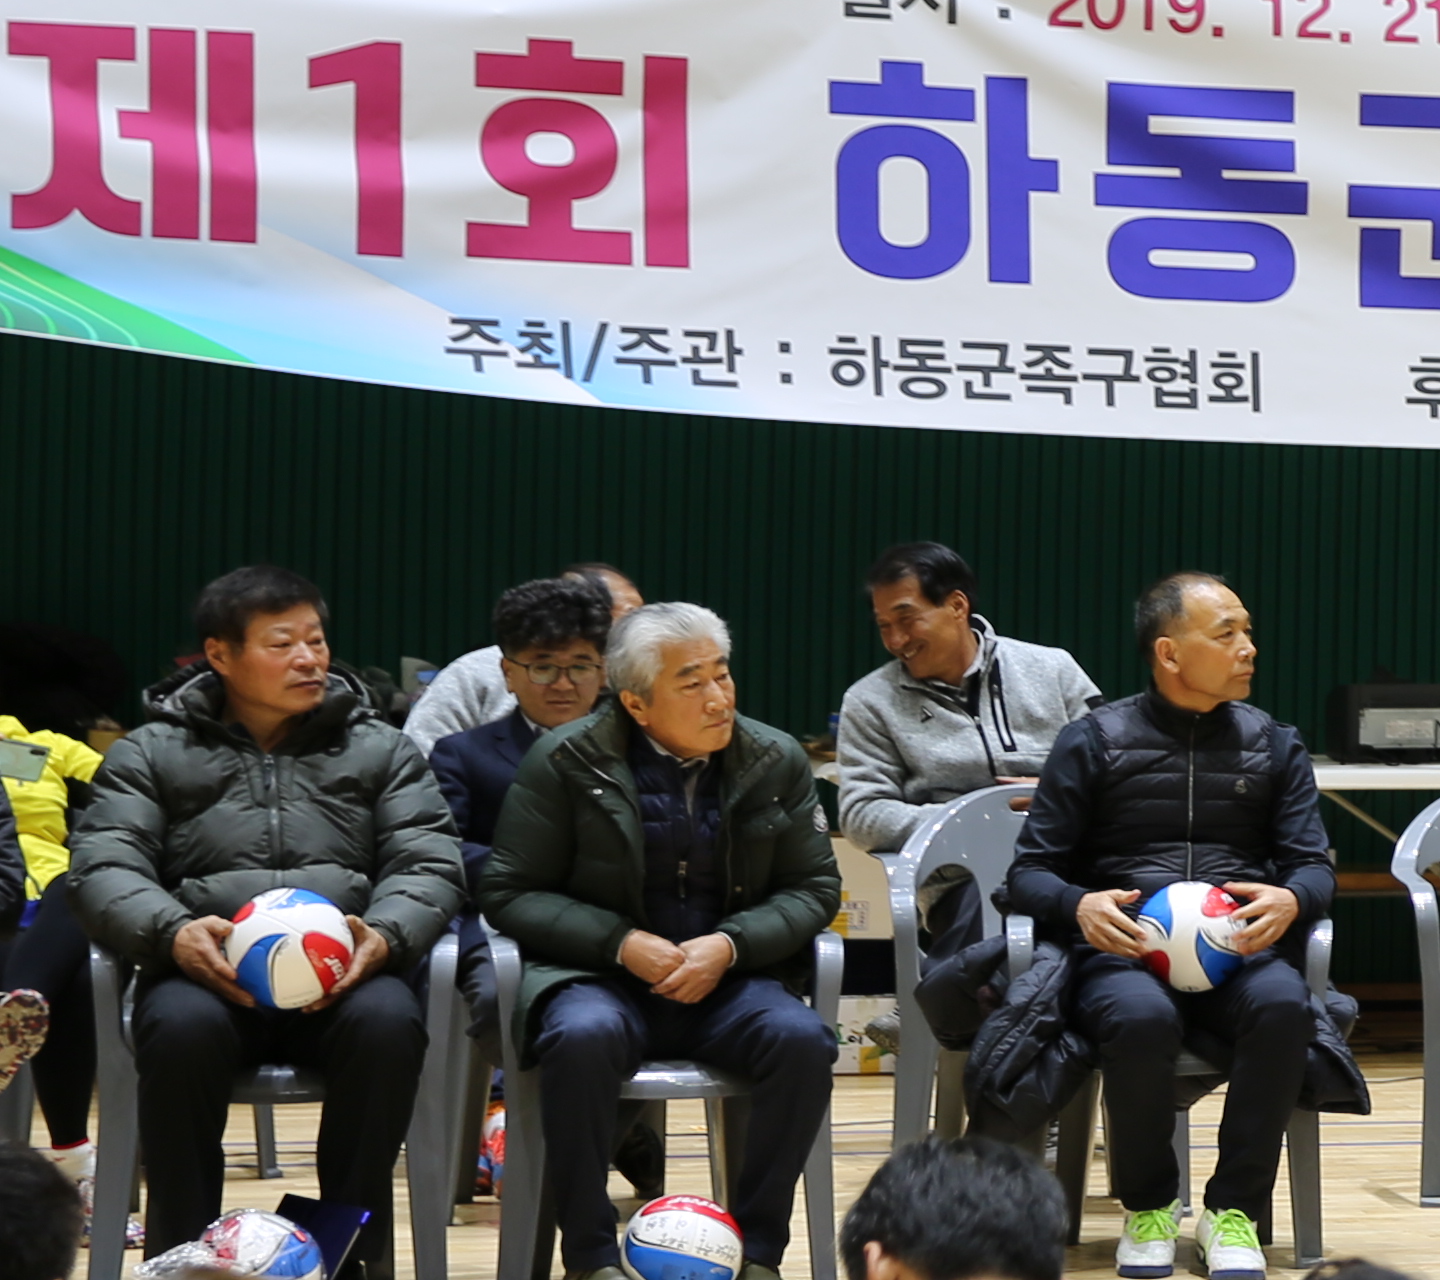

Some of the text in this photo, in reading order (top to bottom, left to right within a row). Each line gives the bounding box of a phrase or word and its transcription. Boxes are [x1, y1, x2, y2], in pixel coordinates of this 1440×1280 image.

[6, 20, 690, 269] 제1회
[444, 316, 743, 389] 주최/주관
[827, 335, 1263, 413] 하동군족구협회
